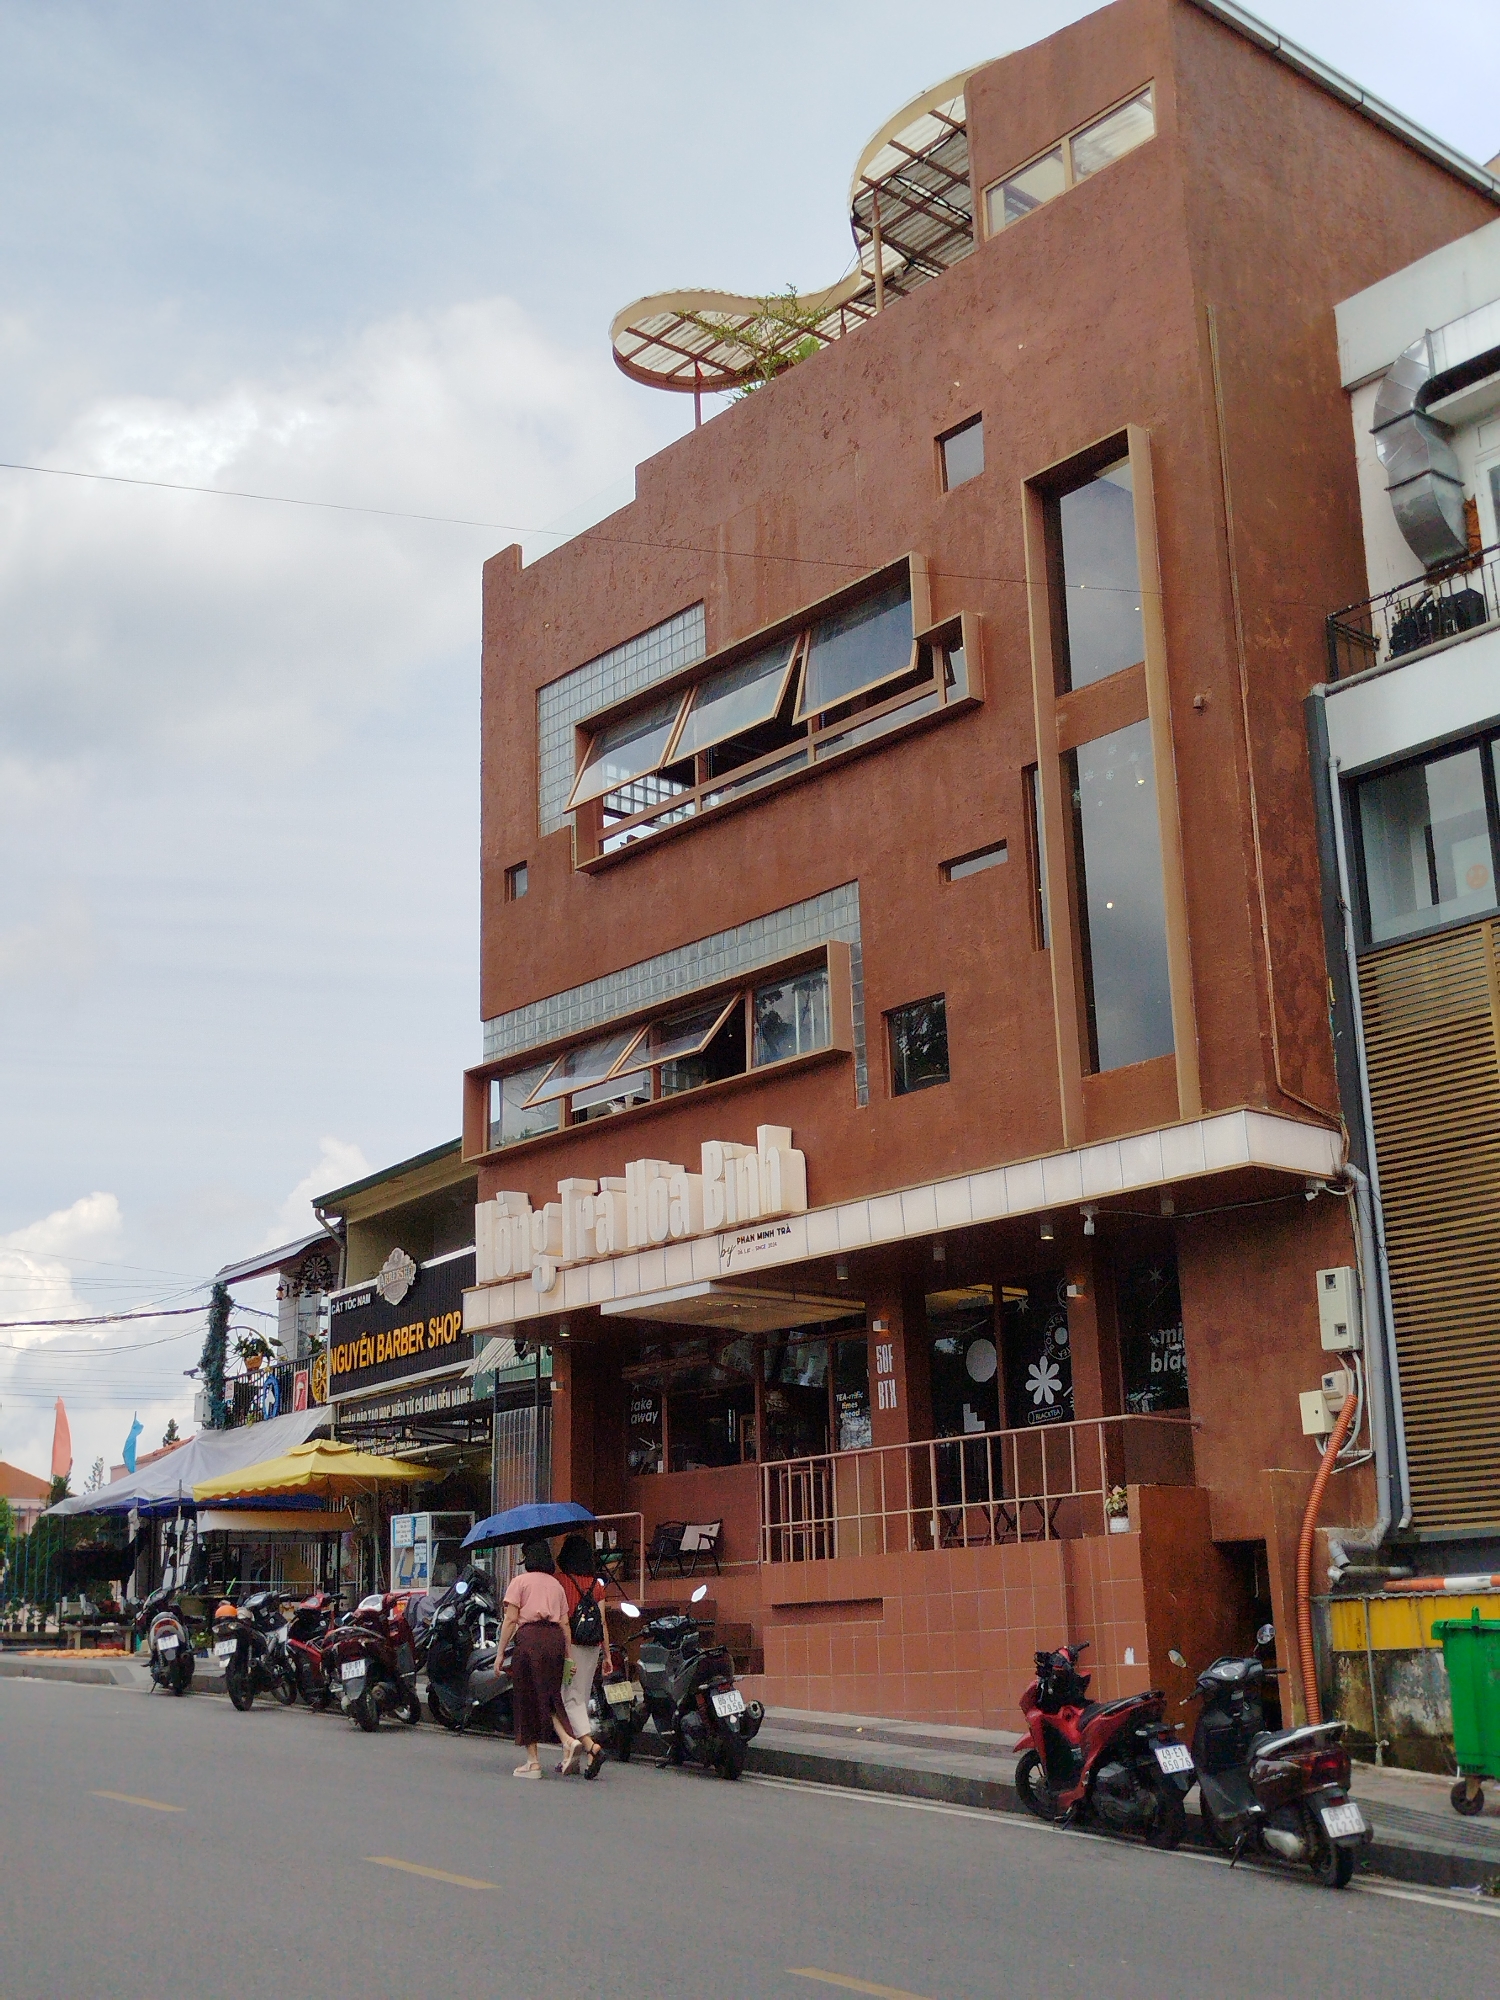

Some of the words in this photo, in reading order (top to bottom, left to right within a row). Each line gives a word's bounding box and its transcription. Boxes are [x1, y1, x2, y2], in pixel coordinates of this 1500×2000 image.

[557, 1178, 620, 1263] Trà
[625, 1159, 695, 1242] Hòa
[701, 1124, 798, 1230] Bình
[720, 1234, 737, 1268] by
[736, 1235, 755, 1246] PHAN
[756, 1229, 775, 1240] MINH
[776, 1222, 792, 1237] TRÀ
[330, 1331, 375, 1376] NGUYỄN
[377, 1321, 424, 1364] BARBER
[427, 1310, 461, 1349] SHOP
[630, 1397, 653, 1412] take
[630, 1410, 659, 1425] away
